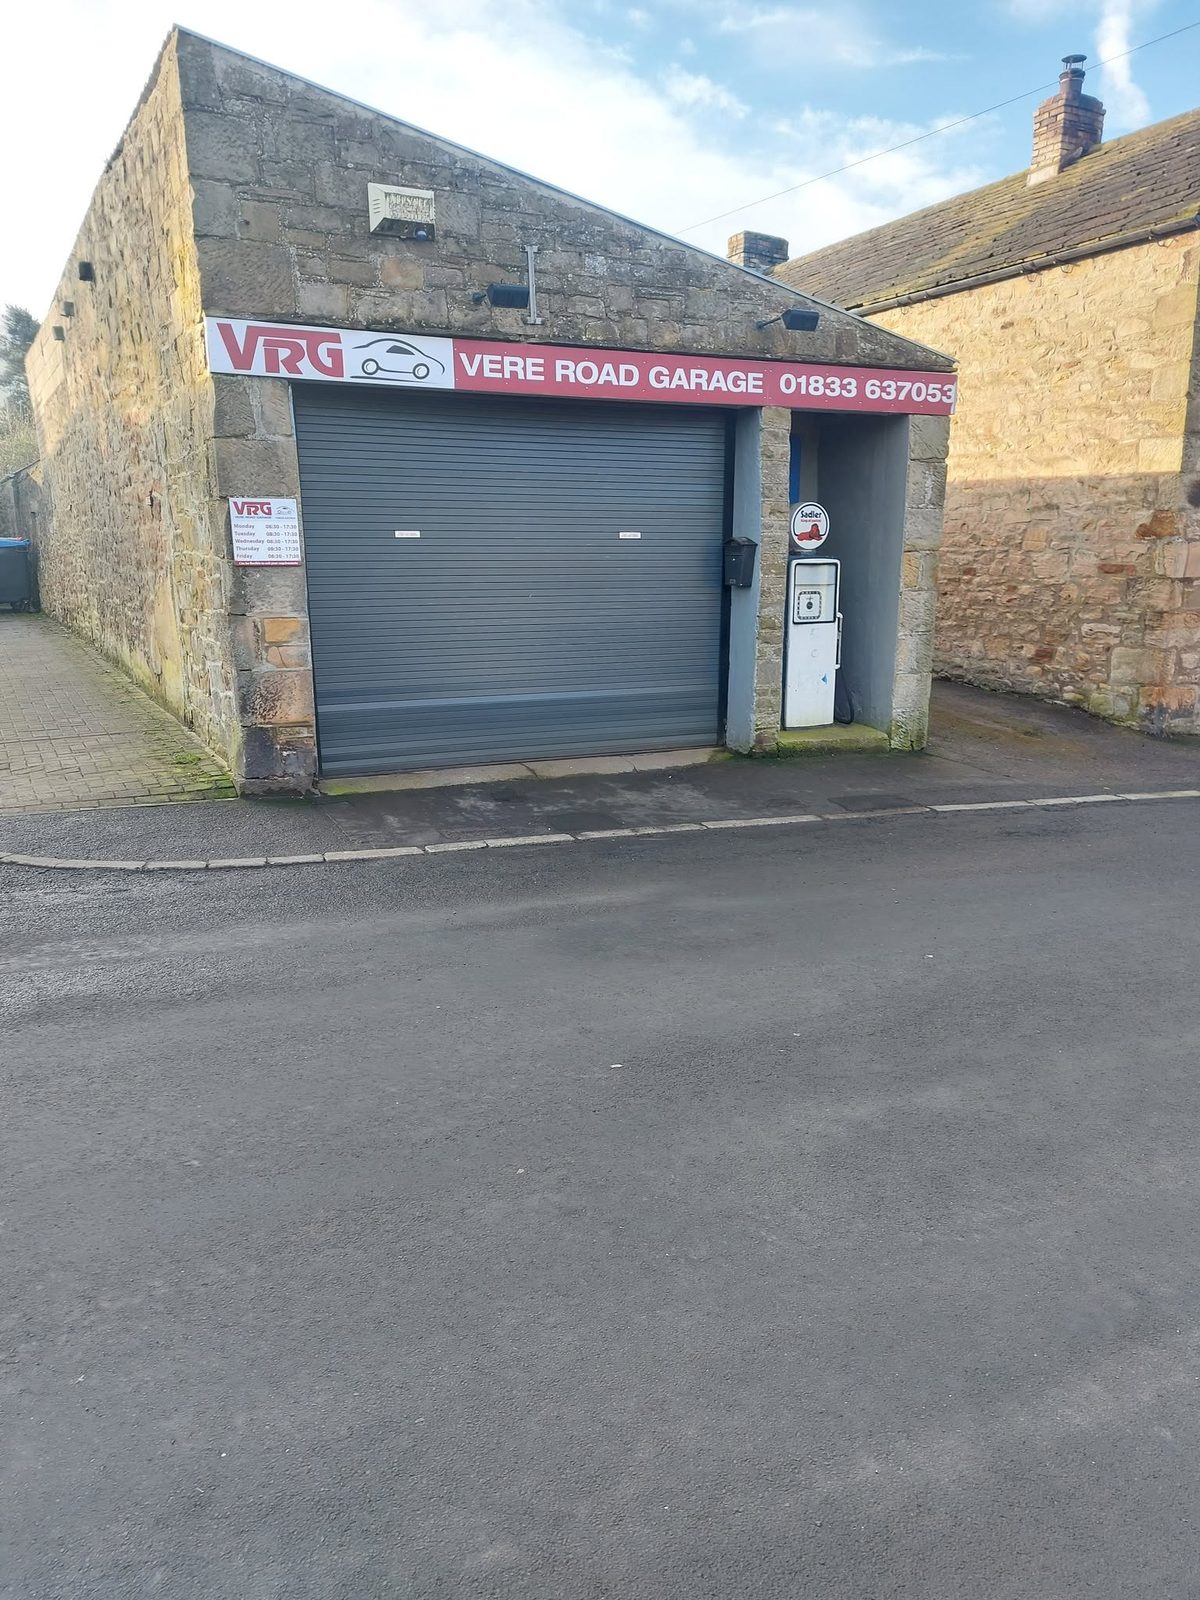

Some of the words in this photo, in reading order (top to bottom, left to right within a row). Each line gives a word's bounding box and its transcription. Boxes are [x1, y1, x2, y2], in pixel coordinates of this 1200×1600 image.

[216, 322, 345, 378] VRG
[459, 352, 545, 381] VERE
[555, 359, 640, 386] ROAD
[648, 366, 764, 394] GARAGE
[779, 373, 857, 398] 01833
[865, 379, 954, 404] 637053
[232, 501, 272, 515] VRG
[800, 510, 822, 518] Sadler
